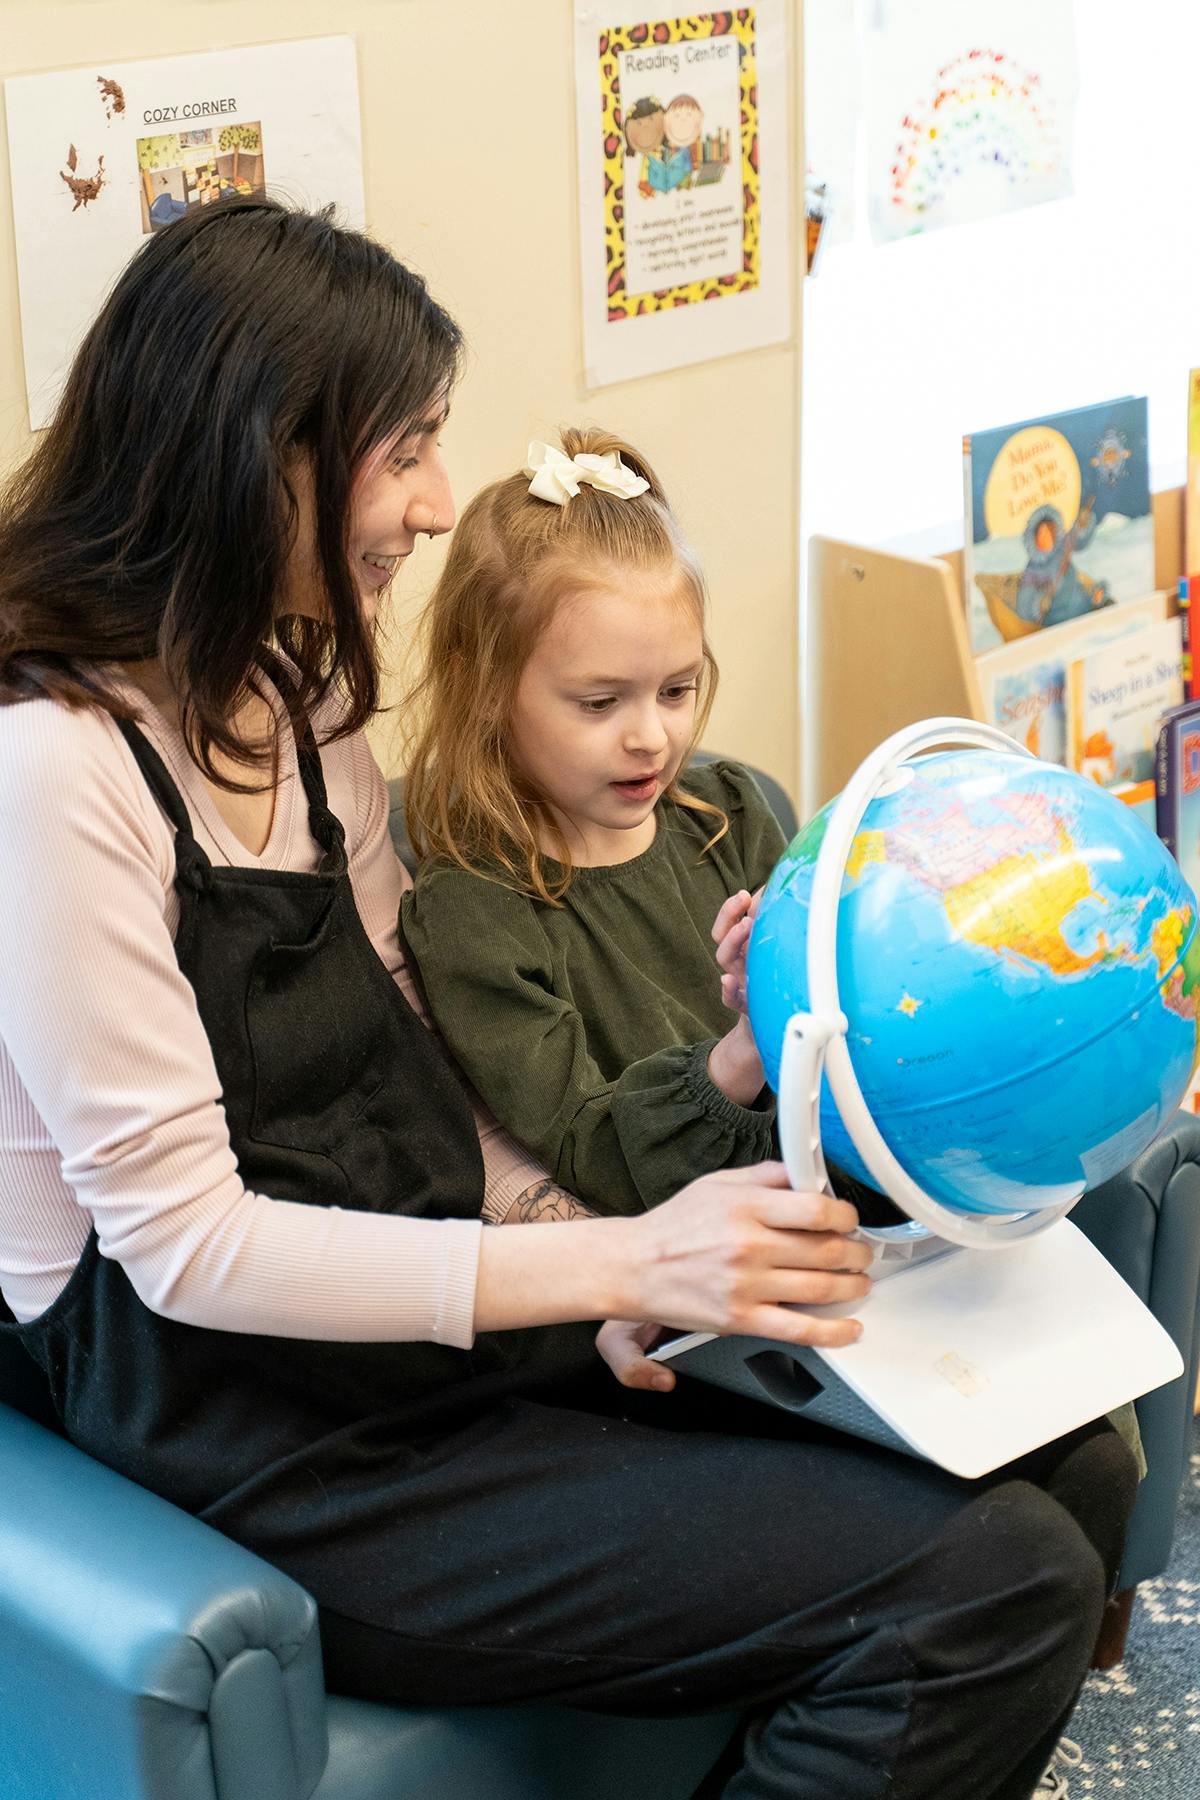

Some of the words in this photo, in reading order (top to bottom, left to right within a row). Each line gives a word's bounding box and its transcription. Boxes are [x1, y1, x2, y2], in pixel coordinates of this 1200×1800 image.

[625, 50, 679, 73] Reading
[685, 44, 731, 63] Center
[143, 106, 178, 123] COZY
[183, 98, 237, 117] CORNER
